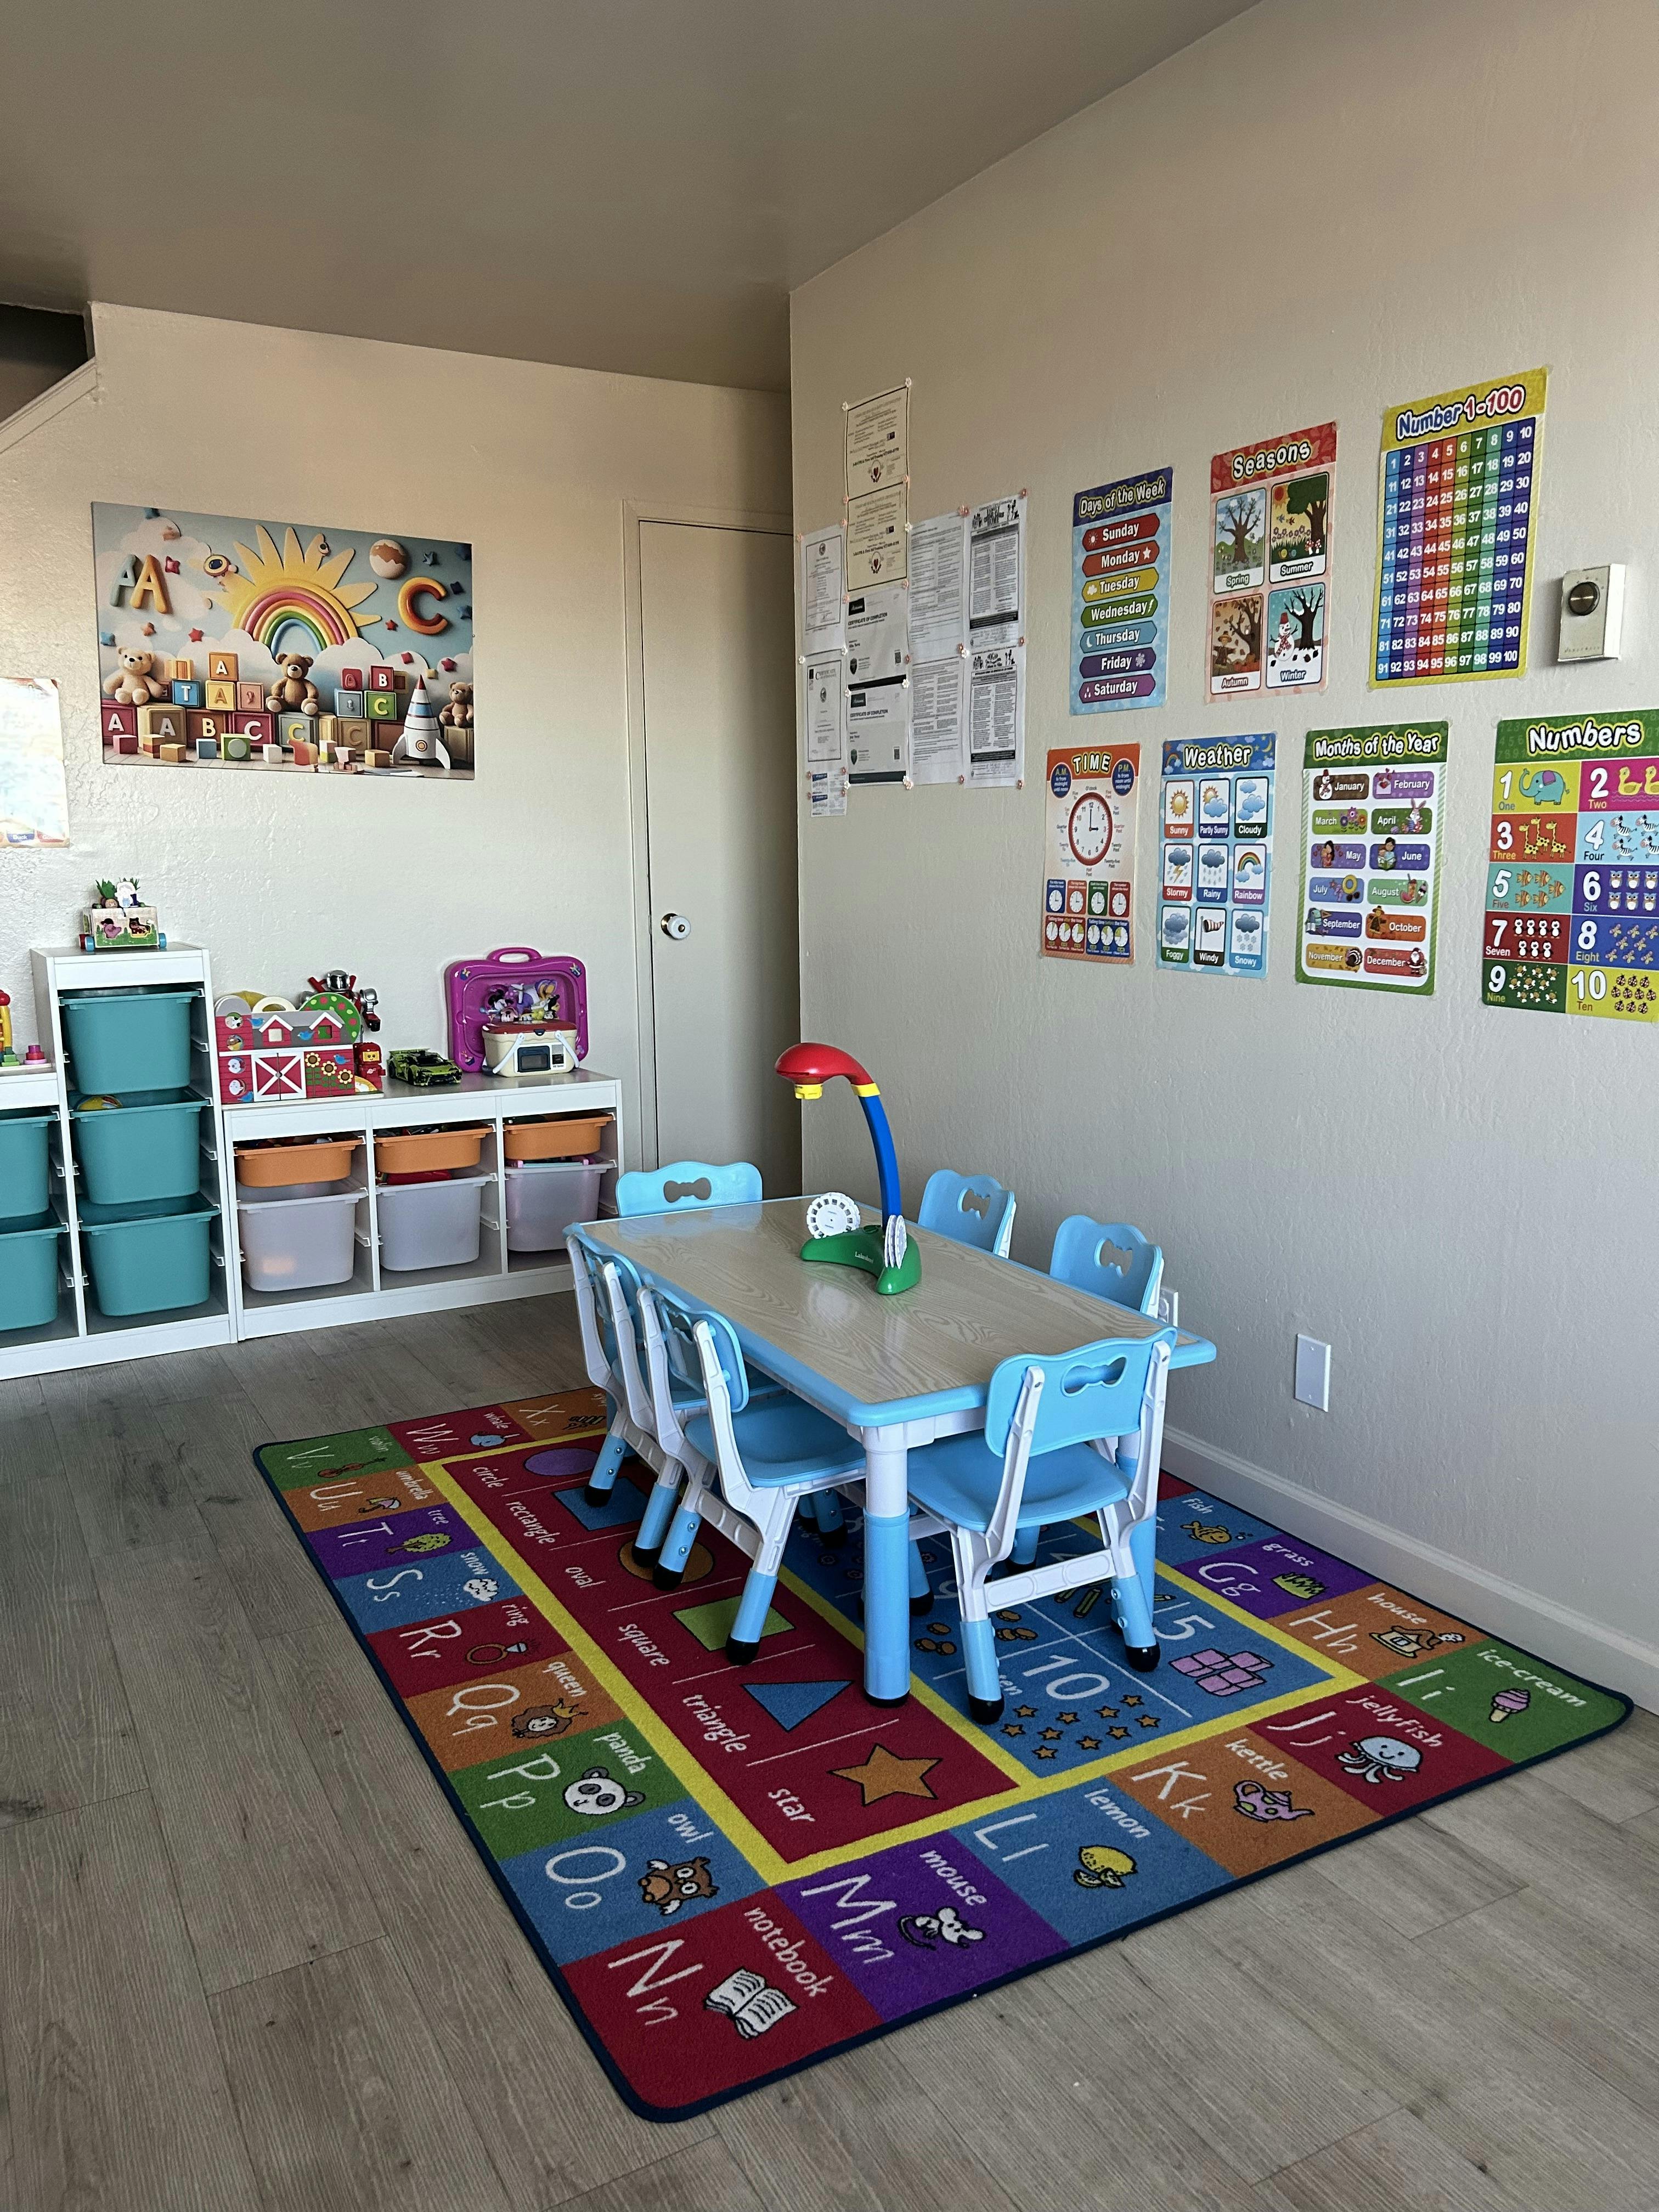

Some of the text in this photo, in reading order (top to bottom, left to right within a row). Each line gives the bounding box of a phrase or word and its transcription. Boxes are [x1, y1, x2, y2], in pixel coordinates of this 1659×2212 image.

[1397, 385, 1525, 439] Number 1-100
[1391, 426, 1532, 469] 1 2 3 4 5 6 7 8 9 10
[1233, 442, 1311, 479] Seasons
[1080, 479, 1165, 516] Days of the Week
[1103, 523, 1139, 541] Sunday
[1102, 550, 1139, 568] Monday
[1280, 562, 1312, 576] Summer
[132, 554, 168, 613] A
[1100, 576, 1139, 593] Tuesday
[1227, 574, 1249, 586] Spring
[398, 577, 448, 635] C
[1091, 602, 1147, 621] Wednesday
[1096, 629, 1139, 646] Thursday
[216, 662, 228, 675] A
[1101, 655, 1132, 670] Friday
[379, 673, 388, 686] B
[1222, 677, 1248, 688] Autumn
[1280, 670, 1306, 681] Winter
[181, 685, 191, 702] T
[214, 687, 227, 703] A
[1094, 680, 1137, 696] Saturday
[374, 698, 388, 715] C
[108, 714, 124, 731] A
[160, 718, 175, 736] A
[202, 719, 215, 737] B
[244, 721, 262, 741] C
[288, 723, 303, 741] C
[1529, 720, 1641, 754] Numbers
[1315, 732, 1439, 759] Months of the Year
[1073, 753, 1111, 774] TIME
[1184, 744, 1251, 767] Weather
[1334, 782, 1364, 792] January
[1394, 779, 1430, 790] February
[1499, 770, 1513, 800] 1
[1590, 768, 1609, 799] 2
[1499, 802, 1515, 811] One
[1588, 799, 1607, 809] Two
[1200, 825, 1228, 835] Partly Sunny
[1316, 817, 1337, 825] March
[1378, 816, 1396, 826] April
[1170, 827, 1188, 836] Sunny
[1239, 826, 1261, 835] Cloudy
[1497, 821, 1513, 850] 3
[1584, 820, 1605, 851] 4
[1346, 851, 1361, 861] May
[1402, 852, 1421, 861] June
[1493, 850, 1515, 860] Three
[1584, 851, 1604, 861] Four
[1313, 886, 1328, 895] July
[1372, 887, 1399, 897] August
[1493, 869, 1511, 898] 5
[1583, 871, 1601, 902] 6
[1166, 888, 1188, 898] Stormy
[1204, 890, 1221, 899] Rainy
[1235, 891, 1262, 900] Rainbow
[1492, 899, 1509, 909] Five
[1583, 902, 1598, 912] Six
[1323, 919, 1361, 930] September
[1389, 923, 1421, 933] October
[1492, 919, 1508, 947] 7
[1578, 920, 1598, 951] 8
[1166, 951, 1183, 960] Foggy
[1199, 953, 1218, 963] Windy
[1308, 951, 1343, 962] November
[1486, 946, 1510, 957] Seven
[1576, 951, 1600, 963] Eight
[1235, 956, 1256, 966] Snowy
[1367, 956, 1406, 967] December
[1488, 965, 1506, 993] 9
[1571, 970, 1606, 1001] 10
[1487, 992, 1505, 1003] Nine
[1577, 1002, 1593, 1011] Ten
[483, 1412, 509, 1429] whale
[369, 1435, 390, 1453] violin
[395, 1470, 433, 1501] umbrella
[472, 1466, 504, 1488] circle
[1181, 1496, 1214, 1516] fish
[427, 1509, 449, 1525] tree
[505, 1500, 556, 1544] rectangle
[461, 1551, 489, 1576] snow
[1261, 1541, 1314, 1568] grass
[565, 1566, 606, 1589] oval
[502, 1603, 529, 1627] ring
[1367, 1592, 1427, 1625] house
[618, 1623, 672, 1667] square
[543, 1661, 587, 1699] queen
[1023, 1654, 1111, 1701] 10
[1476, 1647, 1589, 1708] ice-cream
[682, 1693, 751, 1753] triangle
[1346, 1694, 1443, 1750] jellyfish
[593, 1732, 652, 1775] panda
[1225, 1738, 1289, 1781] kettle
[768, 1787, 815, 1825] star
[1084, 1788, 1153, 1840] lemon
[667, 1813, 715, 1843] owl
[918, 1849, 989, 1906] mouse
[743, 1906, 833, 1999] notebook
